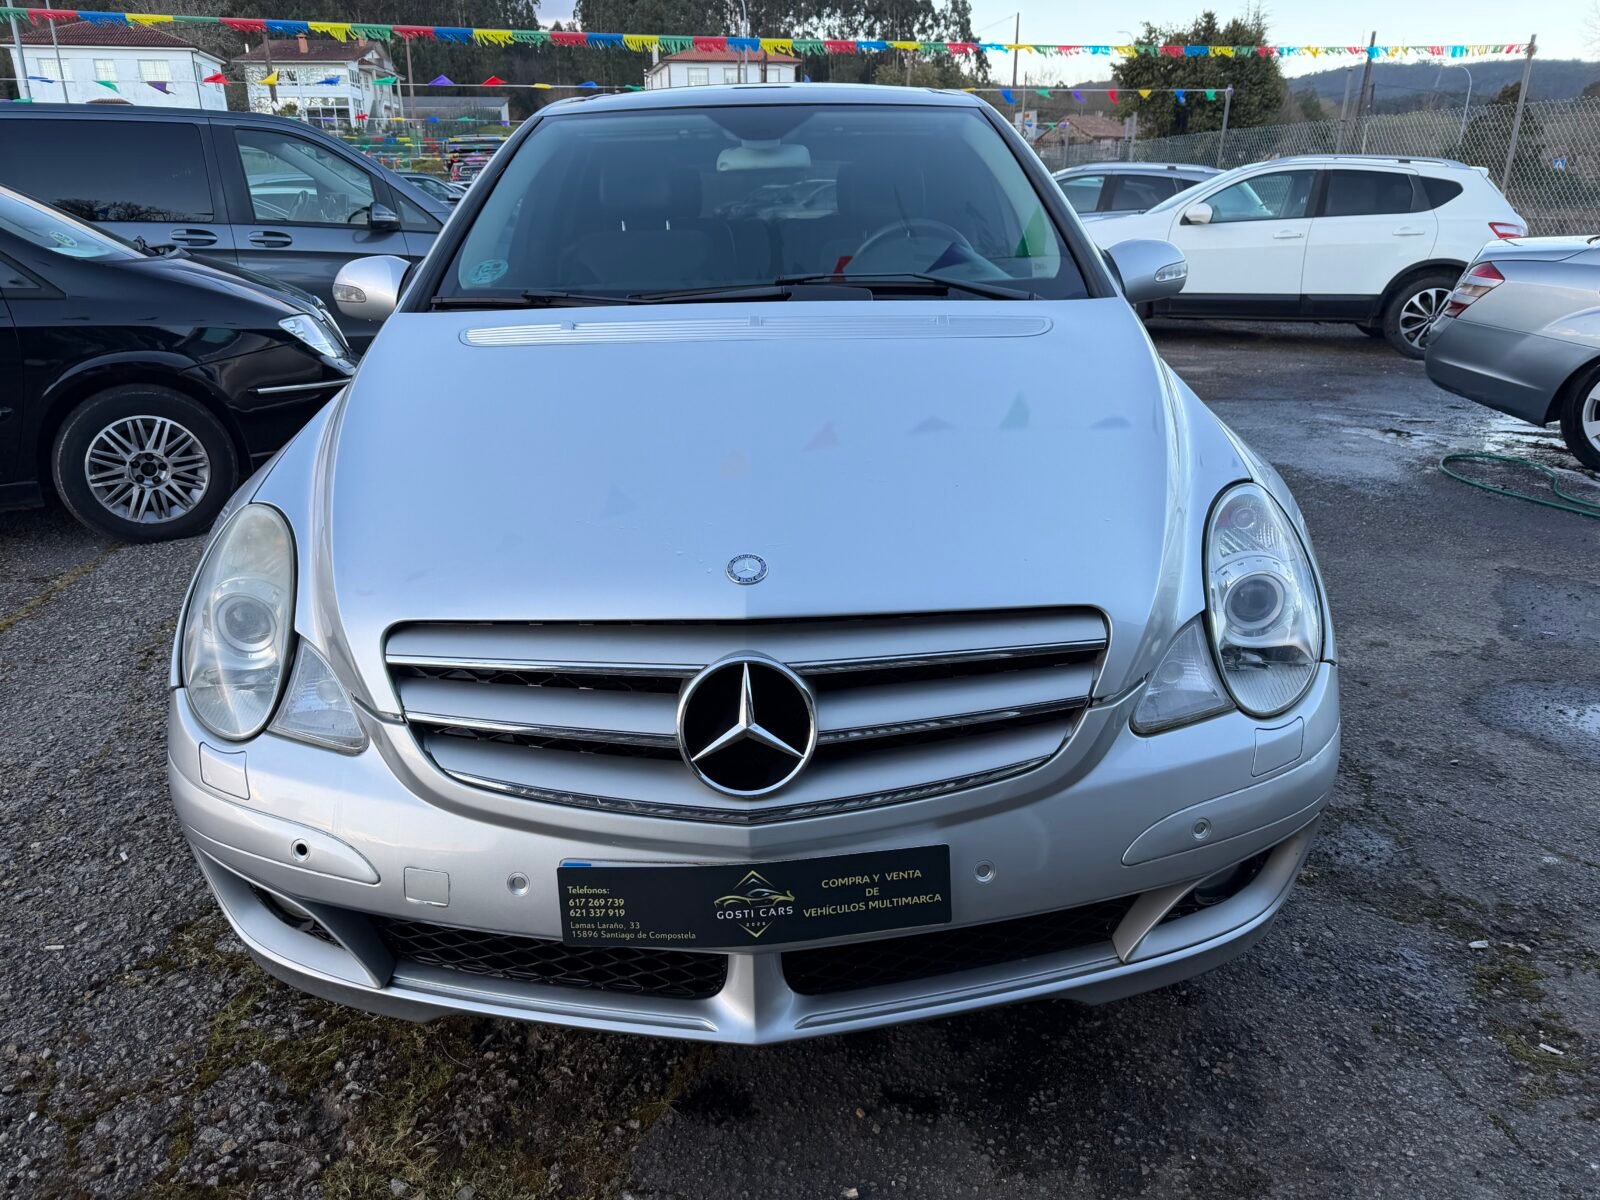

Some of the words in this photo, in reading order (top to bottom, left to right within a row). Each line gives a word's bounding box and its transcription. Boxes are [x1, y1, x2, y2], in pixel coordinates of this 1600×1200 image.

[821, 875, 870, 888] COMPRA
[873, 874, 880, 882] Y
[885, 869, 922, 880] VENTA
[567, 885, 610, 894] Telefonos:
[865, 887, 880, 897] DE
[568, 898, 585, 907] 617
[588, 898, 605, 907] 269
[606, 898, 625, 907] 739
[803, 902, 866, 917] VEHÍCULOS
[868, 893, 942, 909] MULTIMARCA
[569, 908, 586, 917] 621
[589, 908, 605, 917] 337
[607, 908, 626, 917] 919
[716, 909, 754, 919] GOSTI
[759, 906, 793, 917] CARS
[570, 921, 595, 929] Lamas
[597, 922, 626, 930] Laraño,
[629, 921, 640, 929] 33
[572, 930, 599, 938] 15896
[600, 930, 635, 940] Santiago
[637, 930, 647, 939] de
[649, 931, 696, 940] Compostela
